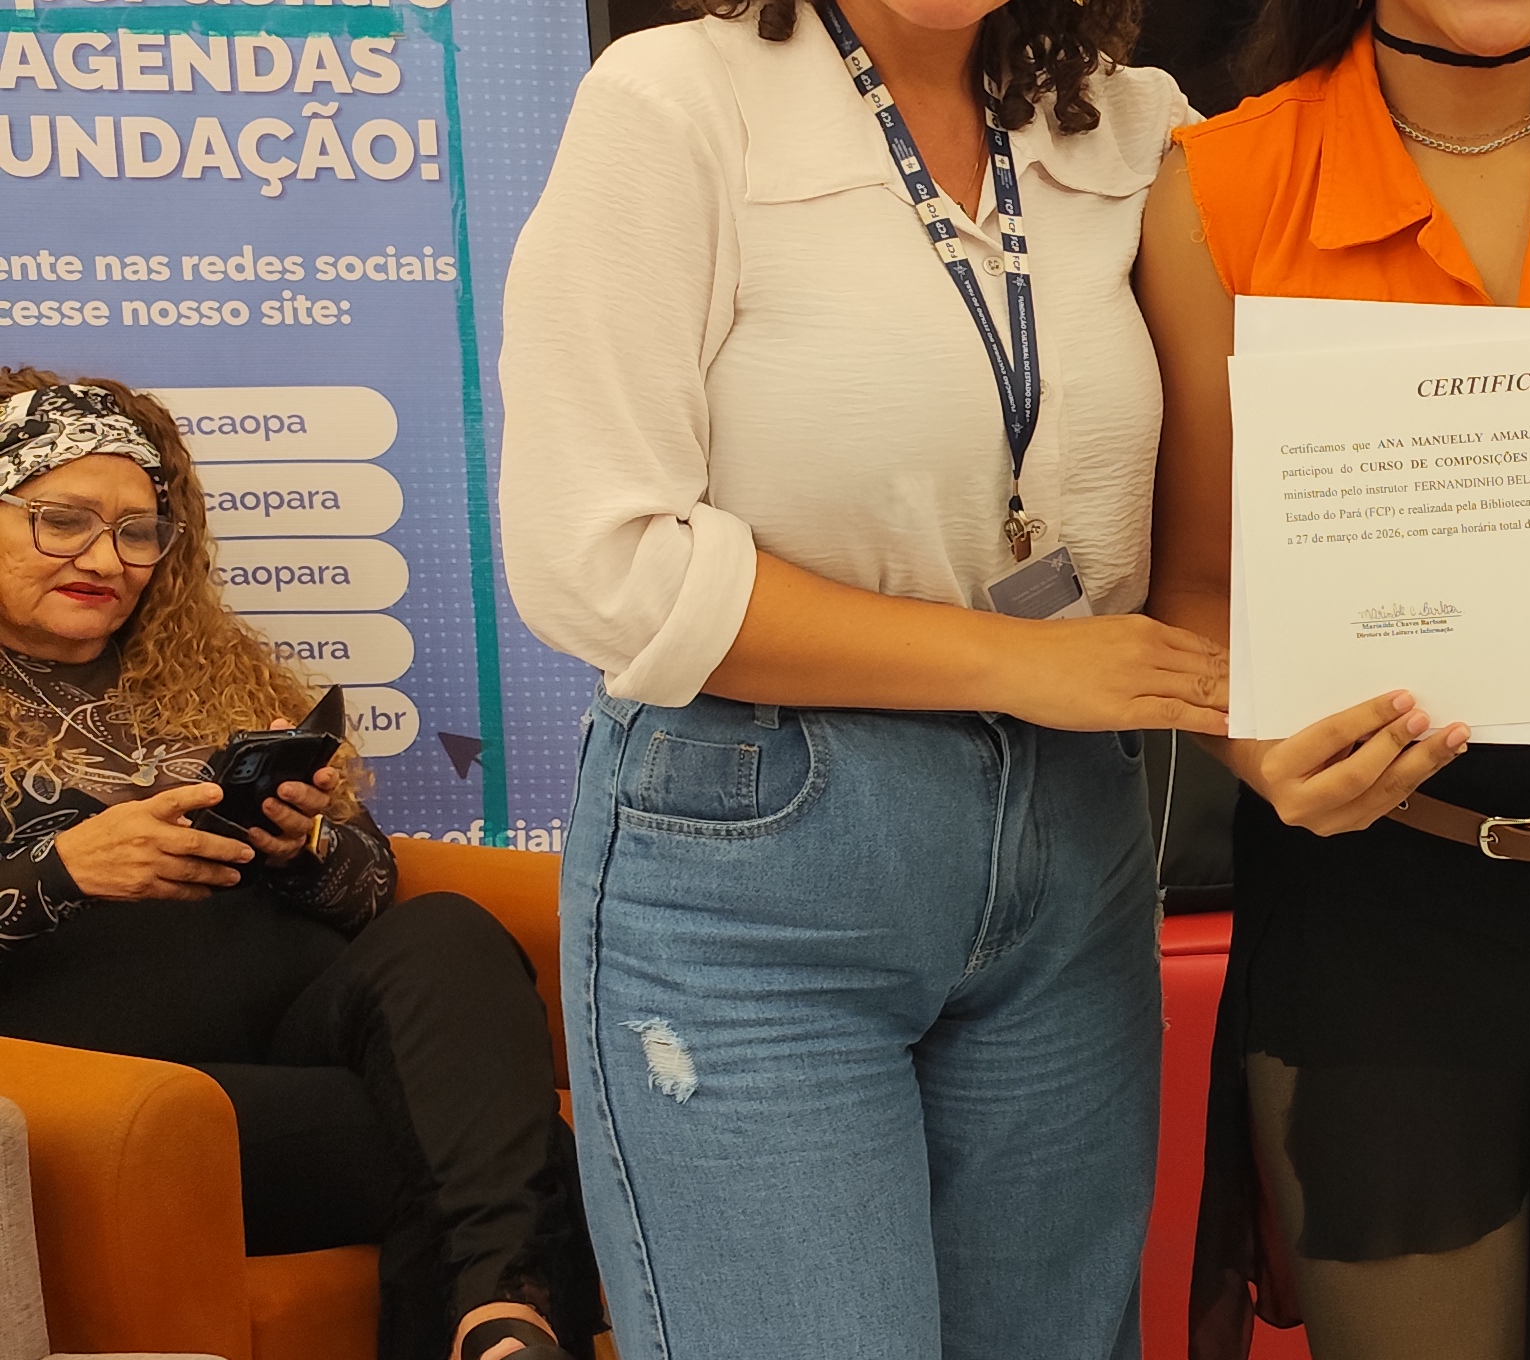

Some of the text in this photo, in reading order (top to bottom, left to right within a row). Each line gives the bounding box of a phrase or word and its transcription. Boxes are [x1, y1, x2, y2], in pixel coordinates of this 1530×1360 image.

[0, 30, 402, 95] AGENDAS
[881, 111, 894, 128] FCP
[916, 183, 930, 200] FCP
[927, 202, 939, 219] FCP
[1004, 198, 1014, 215] FCP
[935, 221, 949, 239] FCP
[946, 242, 958, 259] FCP
[96, 253, 170, 281] nas
[182, 245, 305, 281] redes
[316, 246, 456, 281] sociais
[122, 298, 249, 326] nosso
[261, 291, 351, 325] site:
[1280, 443, 1346, 455] Certificamos
[1352, 442, 1371, 453] que
[1377, 438, 1405, 449] ANA
[1411, 432, 1484, 447] MANUELLY
[1282, 465, 1334, 480] participou
[1340, 463, 1353, 474] do
[1359, 460, 1404, 473] CURSO
[1410, 458, 1429, 470] DE
[1434, 450, 1528, 468] COMPOSIÇÕES
[1284, 487, 1338, 500] ministrado
[1340, 485, 1363, 499] pelo
[1365, 484, 1408, 495] instrutor
[1414, 476, 1504, 492] FERNANDINHO
[1285, 511, 1320, 523] Estado
[1323, 510, 1336, 520] do
[1339, 507, 1362, 519] Pará
[1364, 506, 1396, 519] (FCP)
[1398, 507, 1405, 515] e
[1407, 502, 1453, 515] realizada
[1455, 500, 1477, 514] pela
[1296, 534, 1308, 545] 27
[1311, 533, 1324, 543] de
[1326, 533, 1358, 543] março
[1360, 530, 1373, 540] de
[1375, 528, 1405, 539] 2026,
[1406, 528, 1429, 537] com
[1431, 526, 1459, 537] carga
[1460, 521, 1497, 533] horária
[1499, 519, 1522, 531] total
